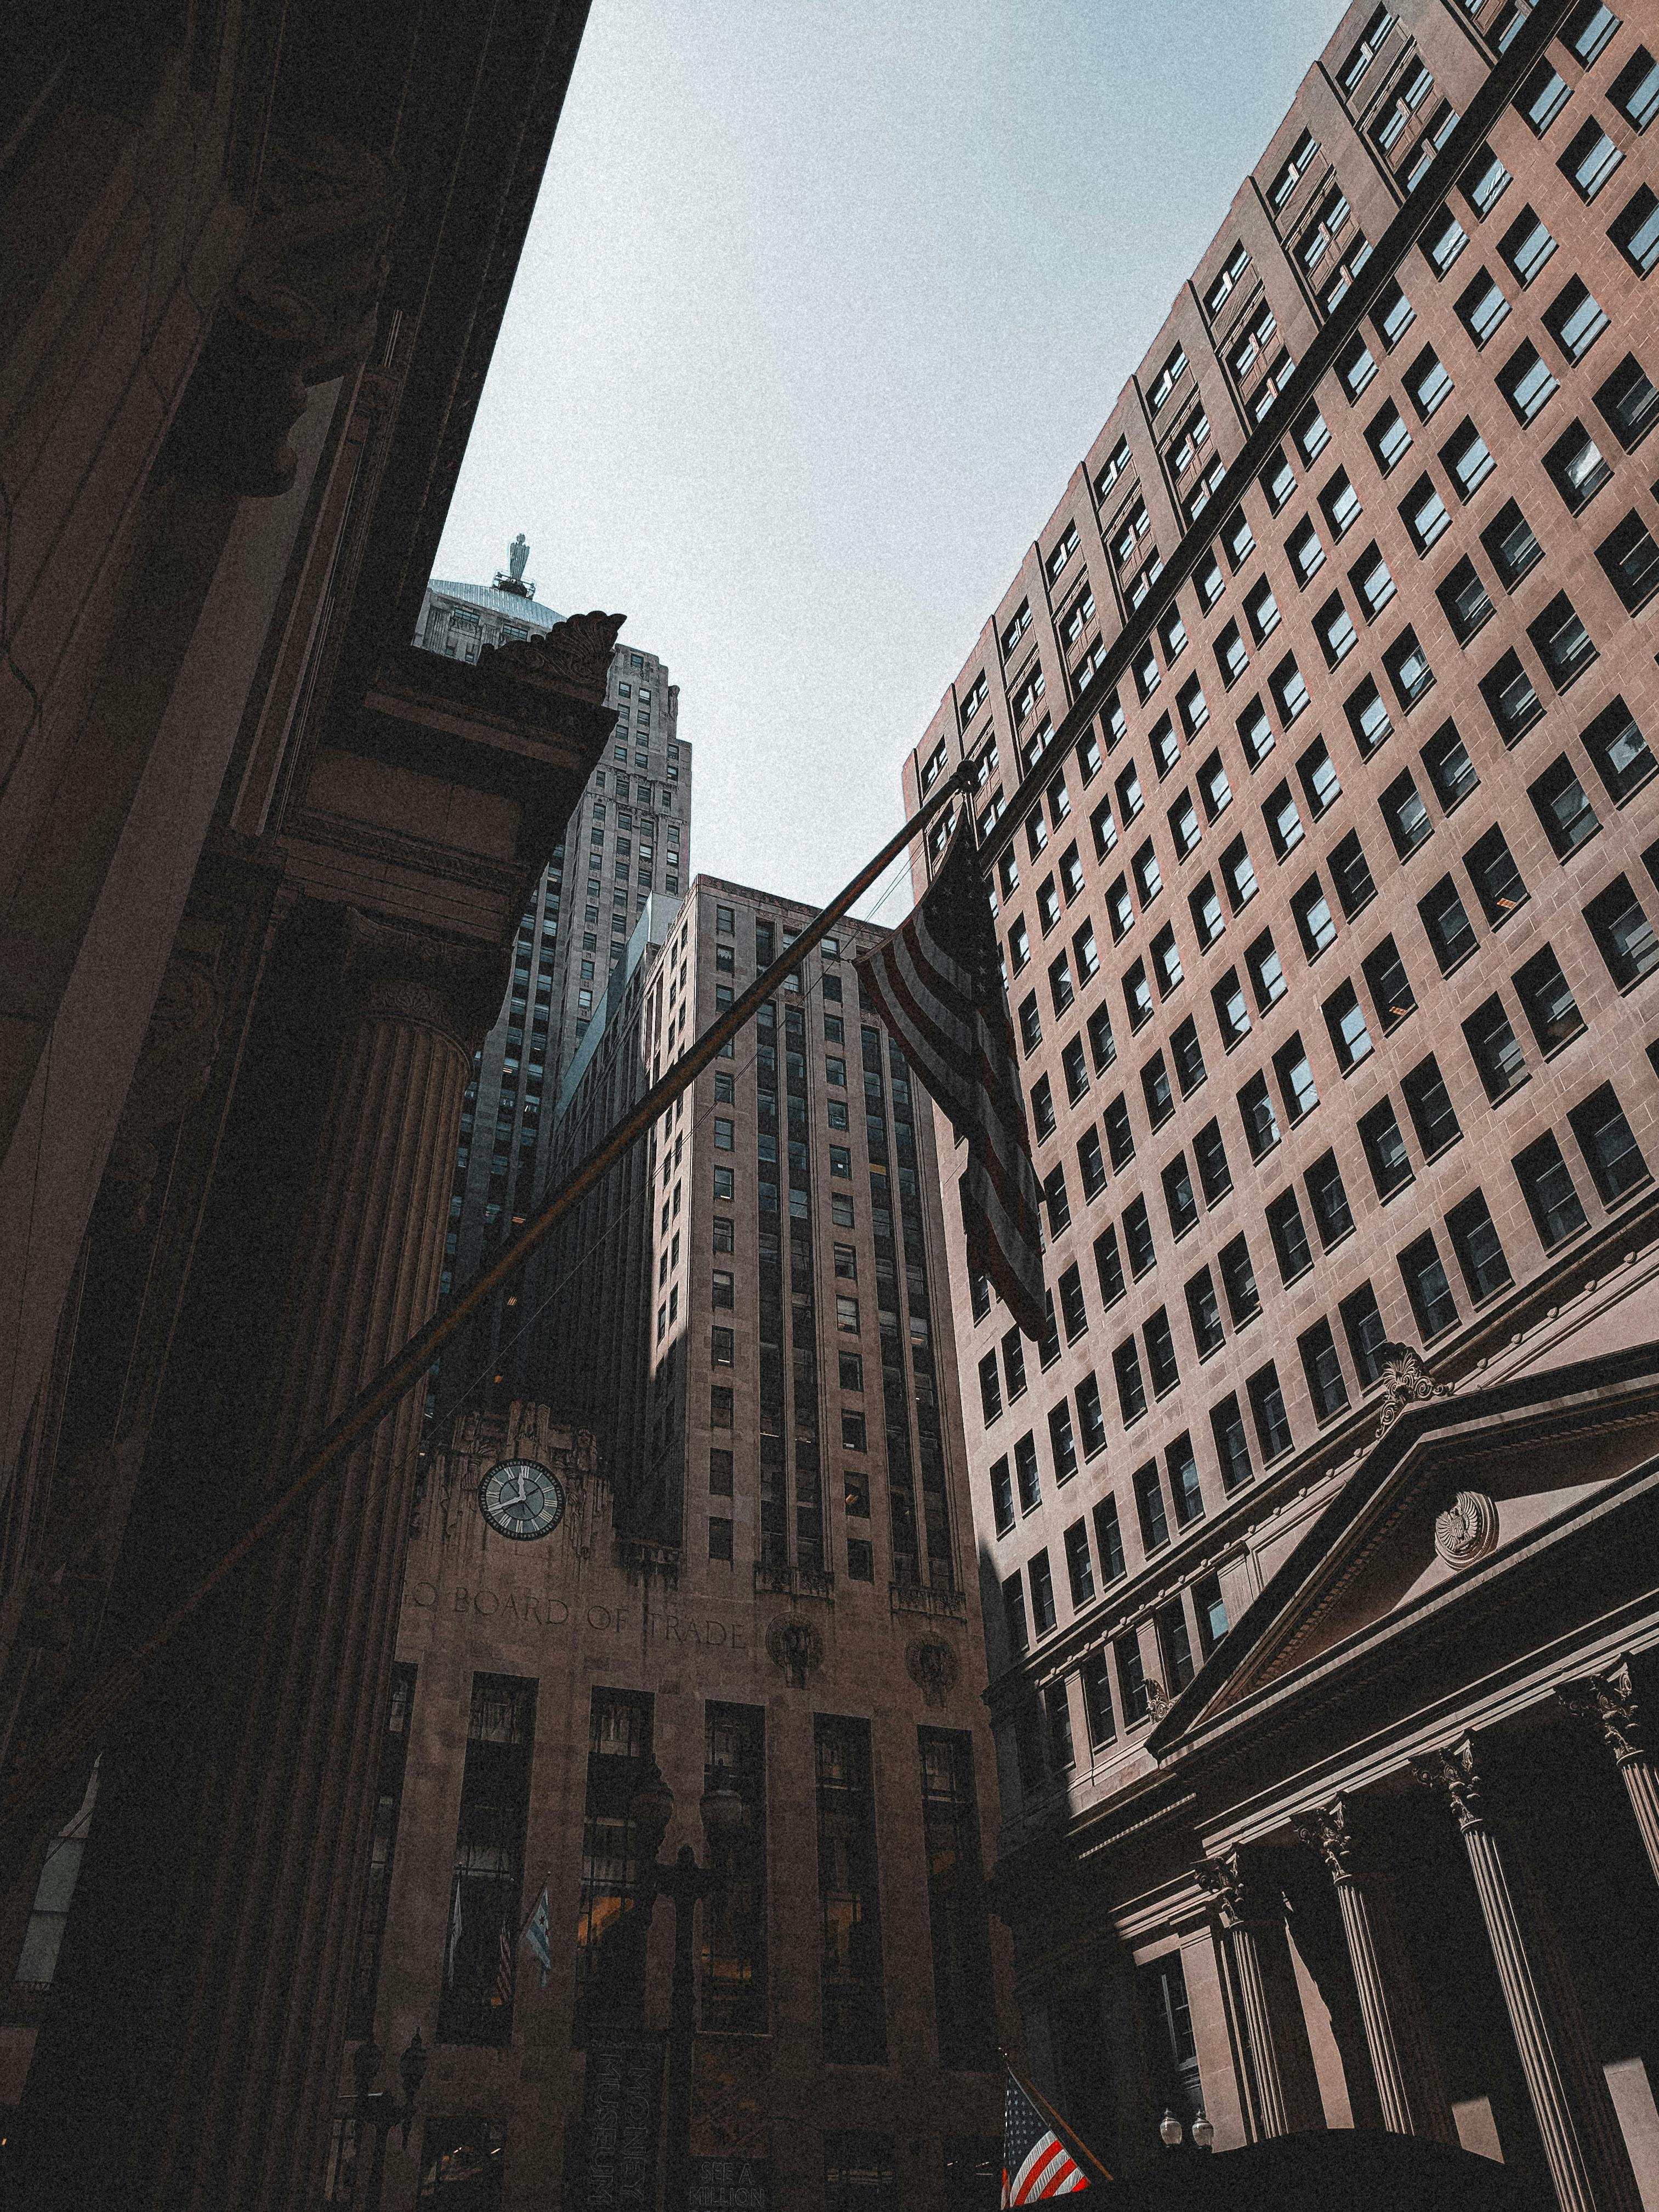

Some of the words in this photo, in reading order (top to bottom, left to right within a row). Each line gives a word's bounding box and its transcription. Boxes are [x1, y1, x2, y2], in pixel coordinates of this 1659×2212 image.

[504, 1466, 515, 1480] XI
[535, 1472, 543, 1483] I
[491, 1476, 504, 1487] X
[542, 1485, 555, 1494] II
[544, 1499, 558, 1508] III
[515, 1520, 523, 1533] VI
[531, 1519, 540, 1531] V
[453, 1586, 570, 1624] BOARD
[587, 1605, 629, 1633] OF
[647, 1612, 746, 1649] TRADE
[587, 2054, 623, 2204] MUSEUM
[620, 2067, 652, 2202] MONEY
[701, 2161, 734, 2184] SEE
[738, 2162, 754, 2185] A
[690, 2186, 766, 2209] MILLION
